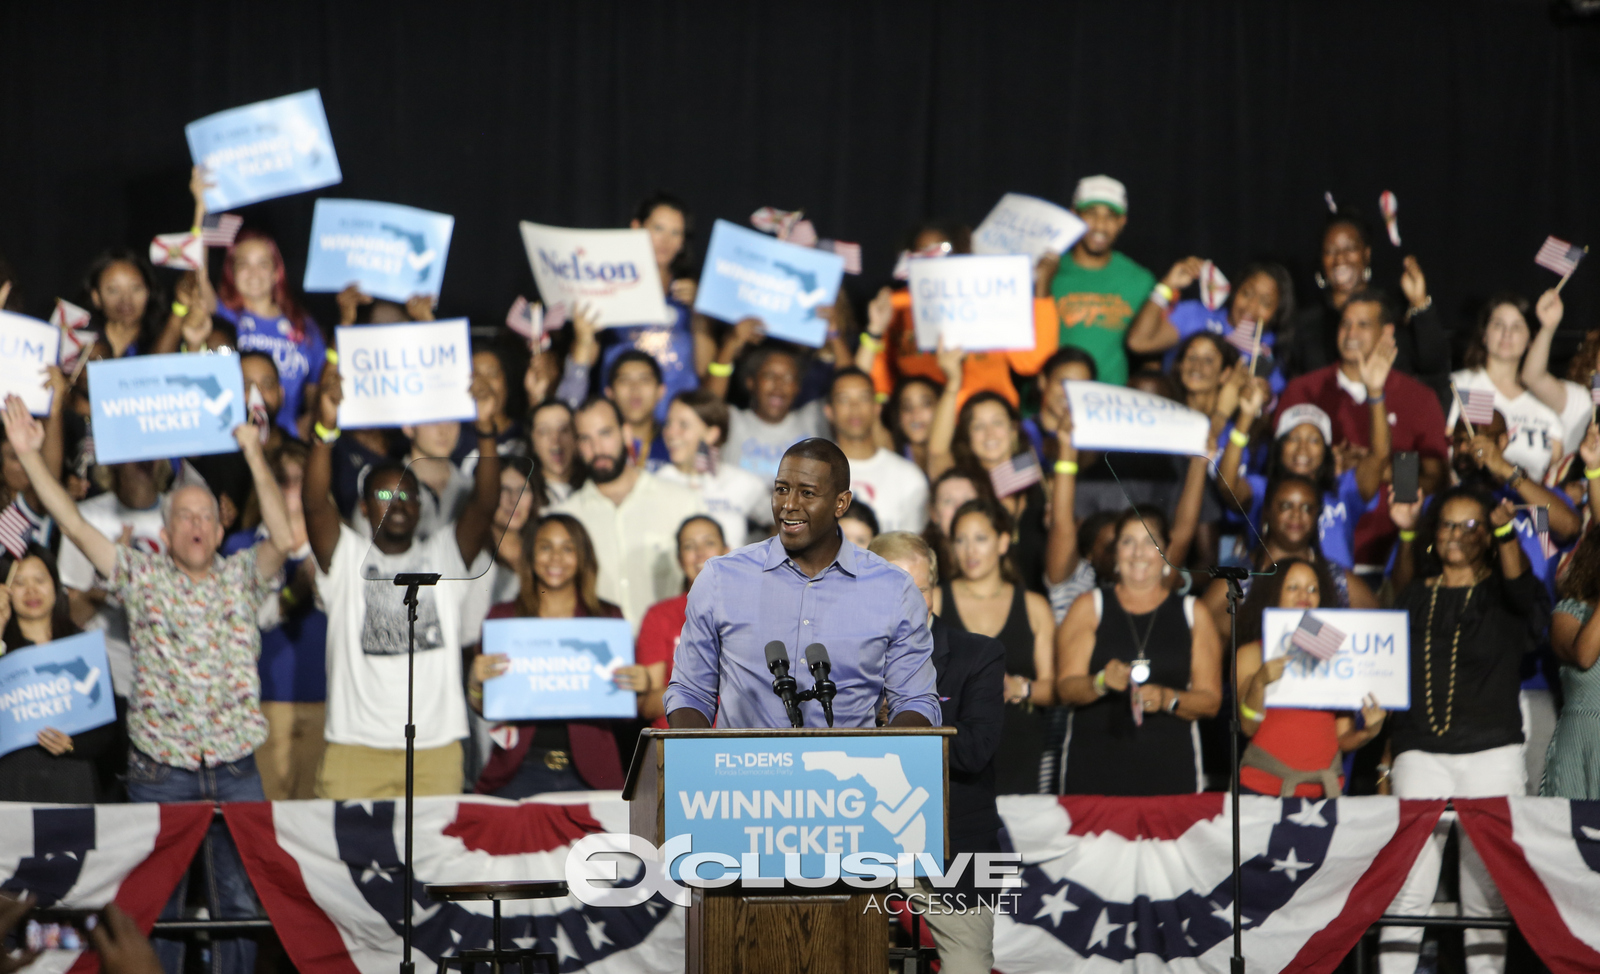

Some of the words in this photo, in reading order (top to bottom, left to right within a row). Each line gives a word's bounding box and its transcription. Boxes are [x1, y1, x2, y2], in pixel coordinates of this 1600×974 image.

[319, 234, 407, 257] WINNING
[536, 248, 637, 281] Nelson
[917, 278, 1017, 300] GILLUM
[351, 343, 457, 374] GILLUM
[353, 372, 423, 397] KING
[101, 391, 200, 418] WINNING
[137, 411, 199, 434] TICKET
[1086, 407, 1155, 427] KING
[528, 673, 590, 691] TICKET
[11, 695, 72, 723] TICKET
[744, 752, 793, 767] DEMS
[715, 768, 737, 776] Florida
[738, 768, 774, 776] Democratic
[776, 768, 793, 777] Party
[678, 787, 866, 820] WINNING
[744, 825, 864, 855] TICKET
